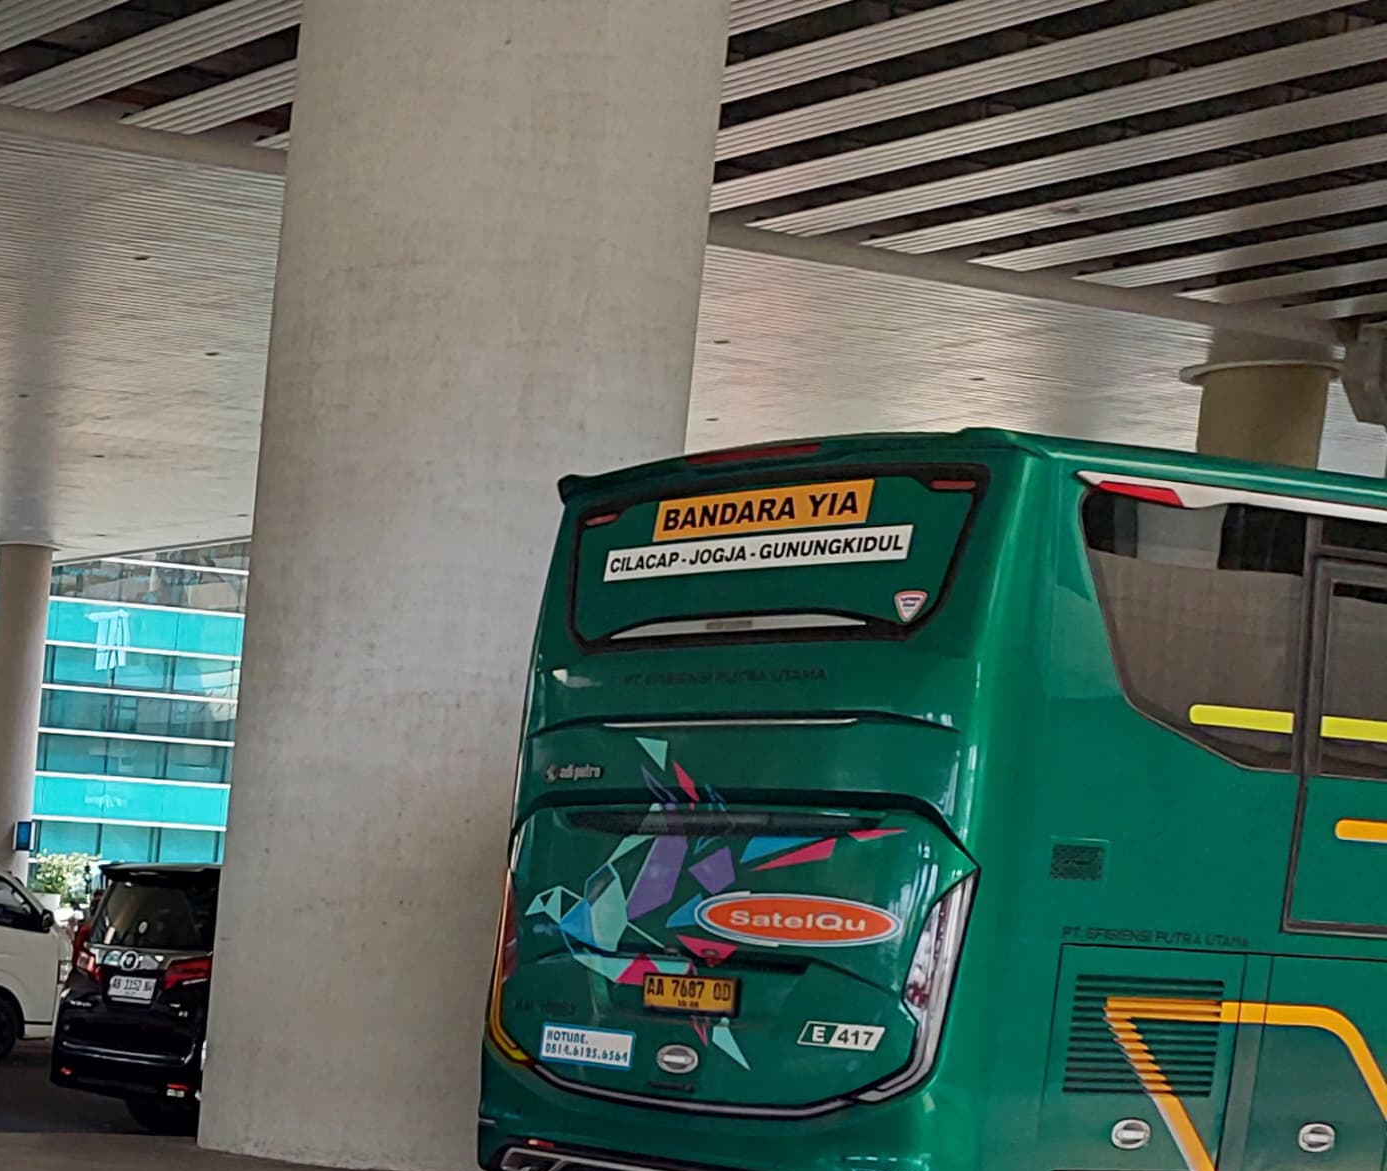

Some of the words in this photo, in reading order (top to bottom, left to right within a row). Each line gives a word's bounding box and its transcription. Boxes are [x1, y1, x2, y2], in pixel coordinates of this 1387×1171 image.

[662, 497, 796, 532] BANDARA
[808, 491, 859, 518] YIA
[610, 551, 680, 573] CILACAP
[689, 545, 747, 566] JOGJA
[759, 535, 904, 560] GUNUNGKIDUL
[730, 910, 866, 932] SatelQu
[647, 978, 664, 995] AA
[811, 1026, 827, 1042] E
[837, 1029, 874, 1046] 417
